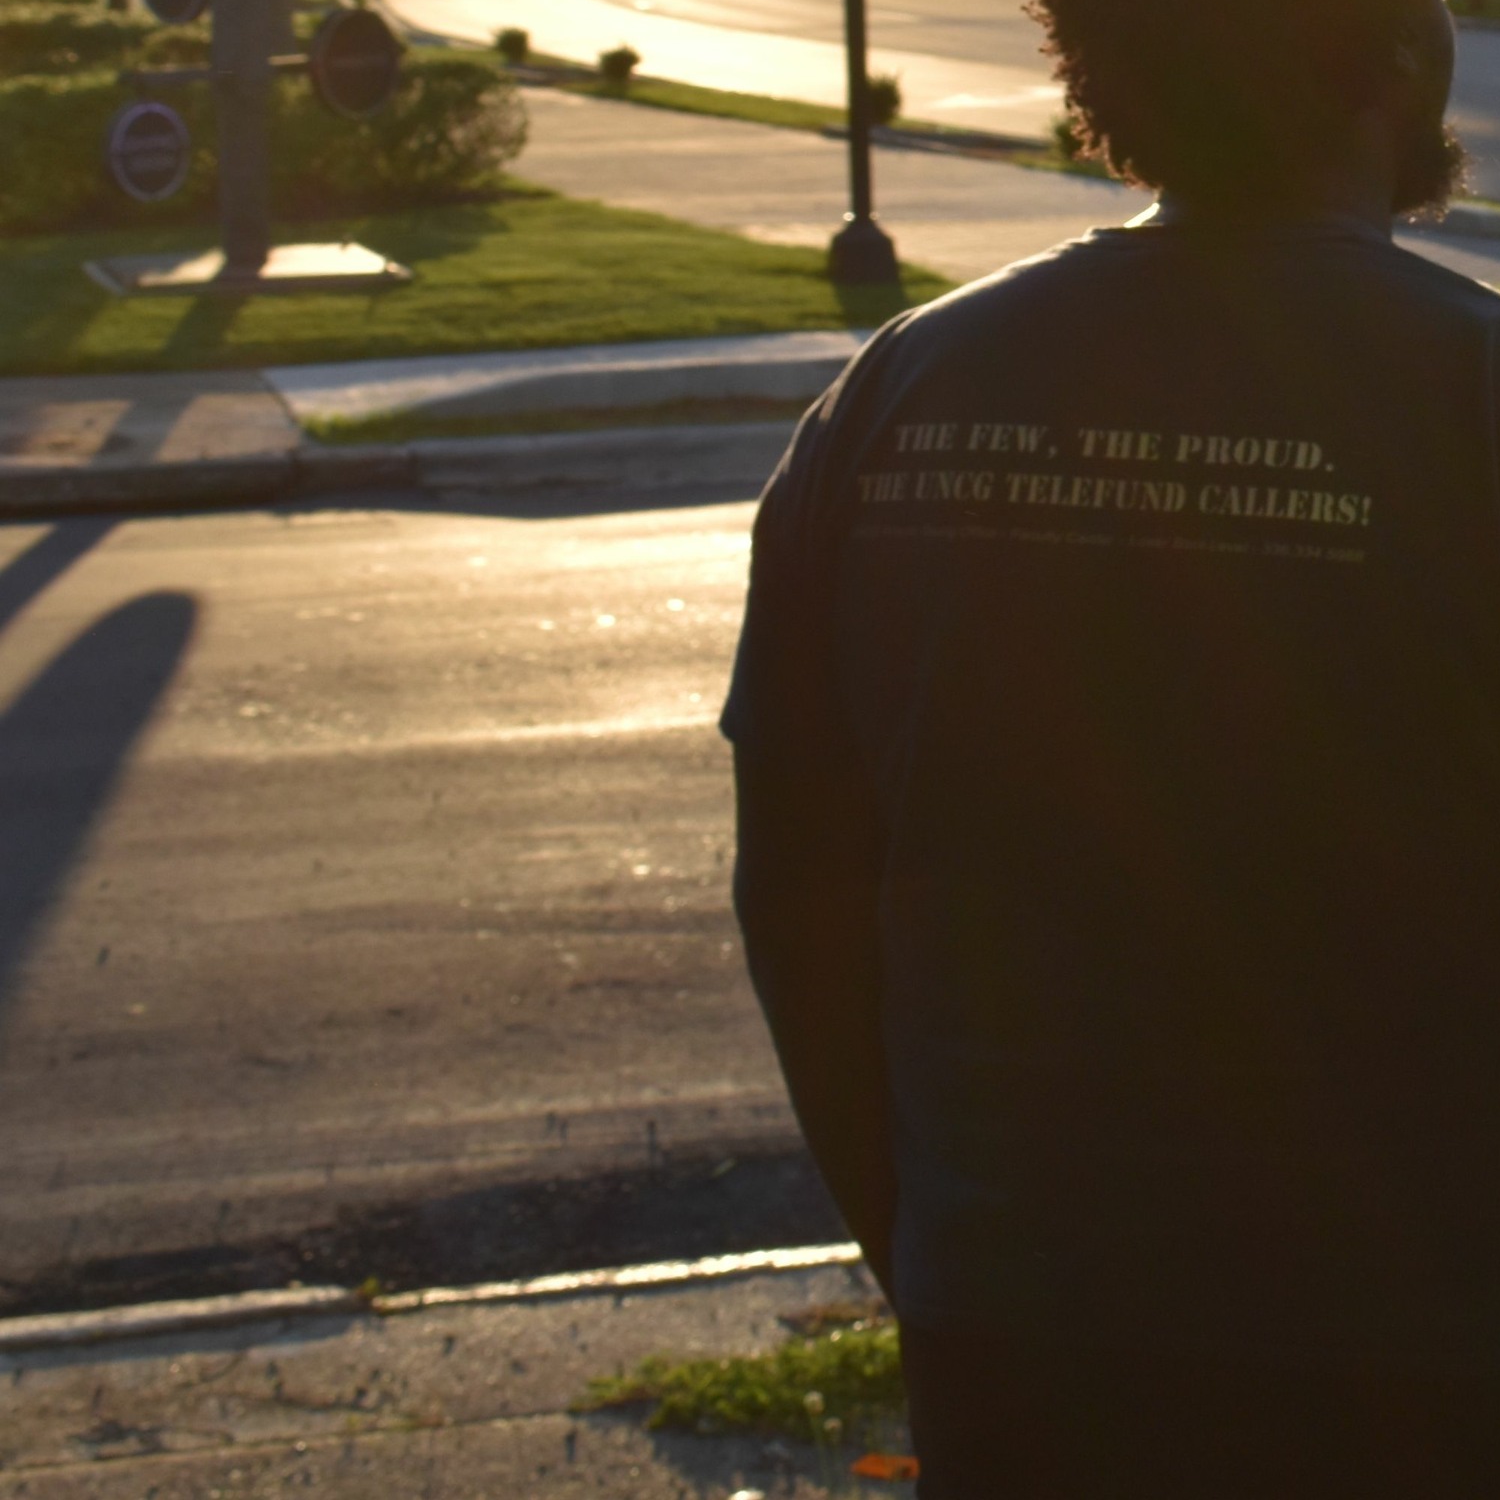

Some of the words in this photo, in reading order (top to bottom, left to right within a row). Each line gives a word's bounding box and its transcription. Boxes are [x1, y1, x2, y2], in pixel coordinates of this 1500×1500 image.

[895, 423, 958, 453] THE
[967, 423, 1058, 459] FEW,
[1077, 427, 1162, 461] THE
[1175, 432, 1335, 472] PROUD.
[857, 471, 908, 503] THE
[915, 470, 995, 501] UNCG
[1006, 473, 1186, 512] TELEFUND
[1199, 483, 1372, 527] CALLERS!
